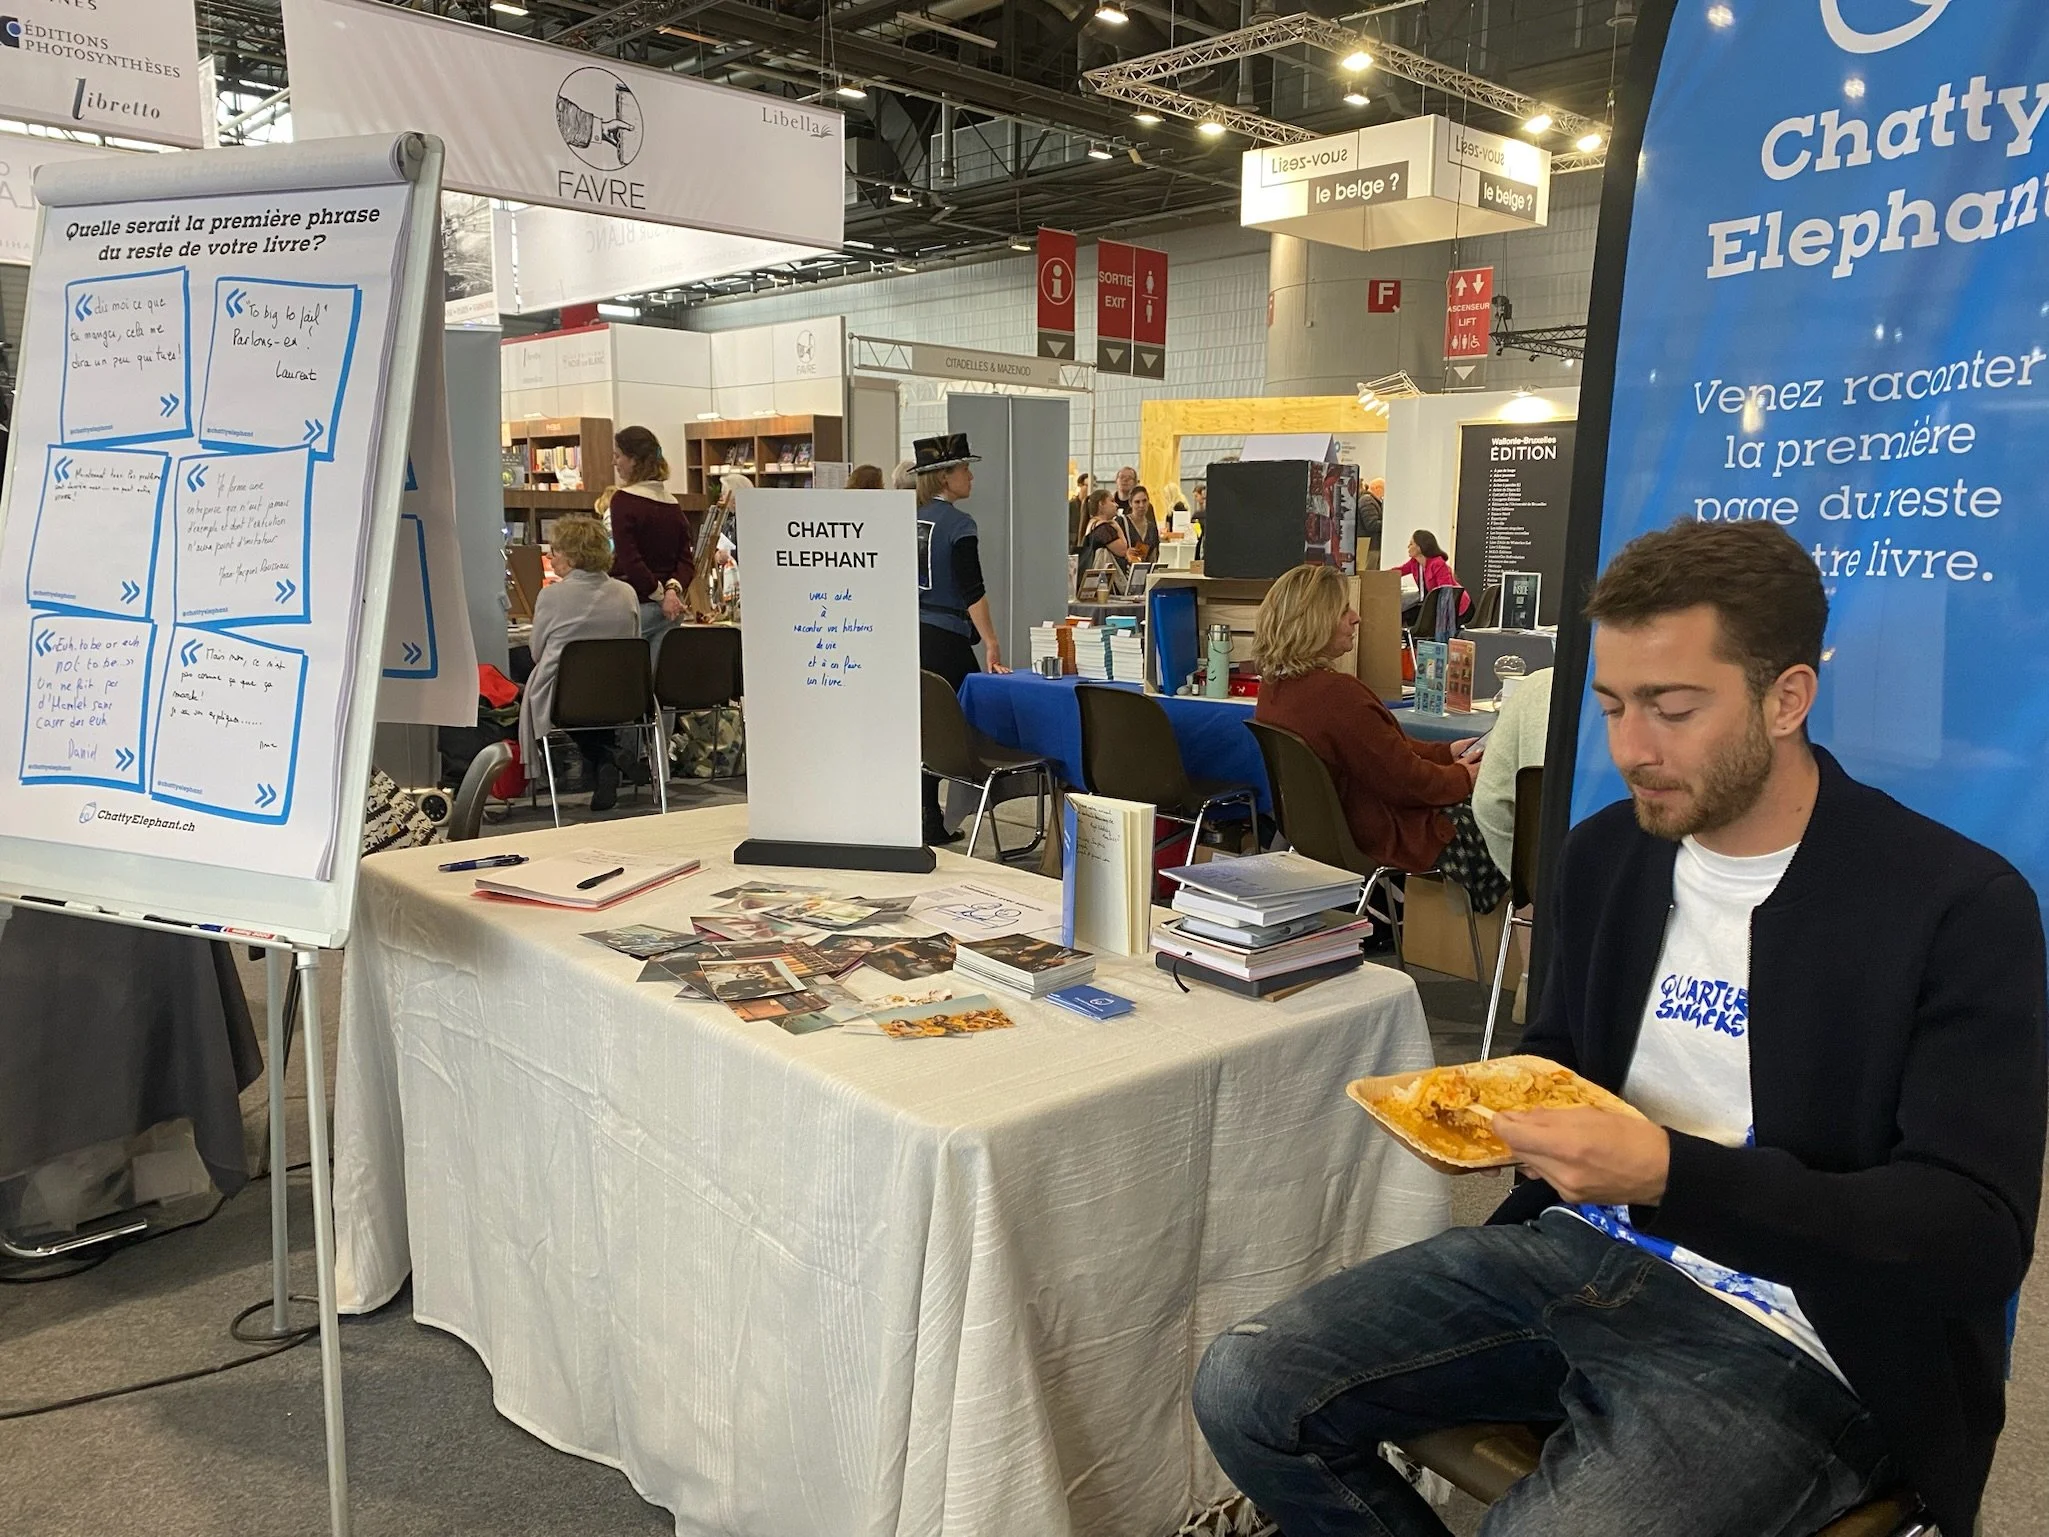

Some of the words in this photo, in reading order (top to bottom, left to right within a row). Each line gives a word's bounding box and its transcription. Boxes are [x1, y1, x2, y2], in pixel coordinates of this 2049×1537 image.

[24, 19, 109, 50] ÉDITIONS
[24, 39, 181, 78] PHOTOSYNTHÈSES
[72, 76, 161, 121] libretto
[762, 106, 820, 134] Libella
[1760, 75, 2049, 181] Chatty
[557, 169, 646, 211] FAVRE
[1315, 184, 1331, 204] le
[1335, 176, 1385, 202] belge
[1483, 182, 1495, 201] le
[1496, 184, 1525, 212] belge
[65, 219, 121, 241] Quelle
[125, 215, 181, 235] serait
[185, 216, 203, 231] la
[208, 208, 301, 235] première
[305, 207, 380, 230] phrase
[1705, 171, 2049, 280] Elephan
[98, 244, 121, 261] du
[126, 242, 173, 260] reste
[178, 240, 201, 257] de
[208, 238, 258, 255] votre
[263, 234, 326, 254] livre?
[1098, 270, 1133, 288] SORTIE
[1104, 295, 1126, 310] EXIT
[1378, 283, 1395, 305] F
[1447, 302, 1490, 313] ASCENSEUR
[1458, 316, 1477, 327] LIFT
[945, 356, 988, 373] CITADELLES
[991, 364, 996, 373] &
[997, 363, 1031, 377] MAZENOD
[1693, 378, 1825, 414] Venez
[1842, 349, 2047, 406] raconter
[1490, 446, 1557, 461] ÉDITION
[1724, 435, 1765, 469] la
[1772, 415, 1976, 478] première
[1819, 485, 1882, 521] du
[1883, 478, 2003, 518] reste
[787, 520, 865, 539] CHATTY
[775, 550, 879, 568] ELEPHANT
[1811, 543, 1861, 577] tre
[1865, 537, 1994, 582] livre.
[809, 591, 828, 601] vous
[834, 588, 852, 601] aide
[793, 624, 823, 633] raconter
[827, 625, 838, 633] vos
[842, 617, 873, 633] histoires
[820, 606, 828, 617] à
[825, 641, 837, 650] vie
[807, 656, 817, 668] et
[821, 658, 828, 668] à
[830, 660, 839, 670] en
[97, 808, 196, 833] ChattyElephant.ch
[1655, 998, 1746, 1037] SNACKS
